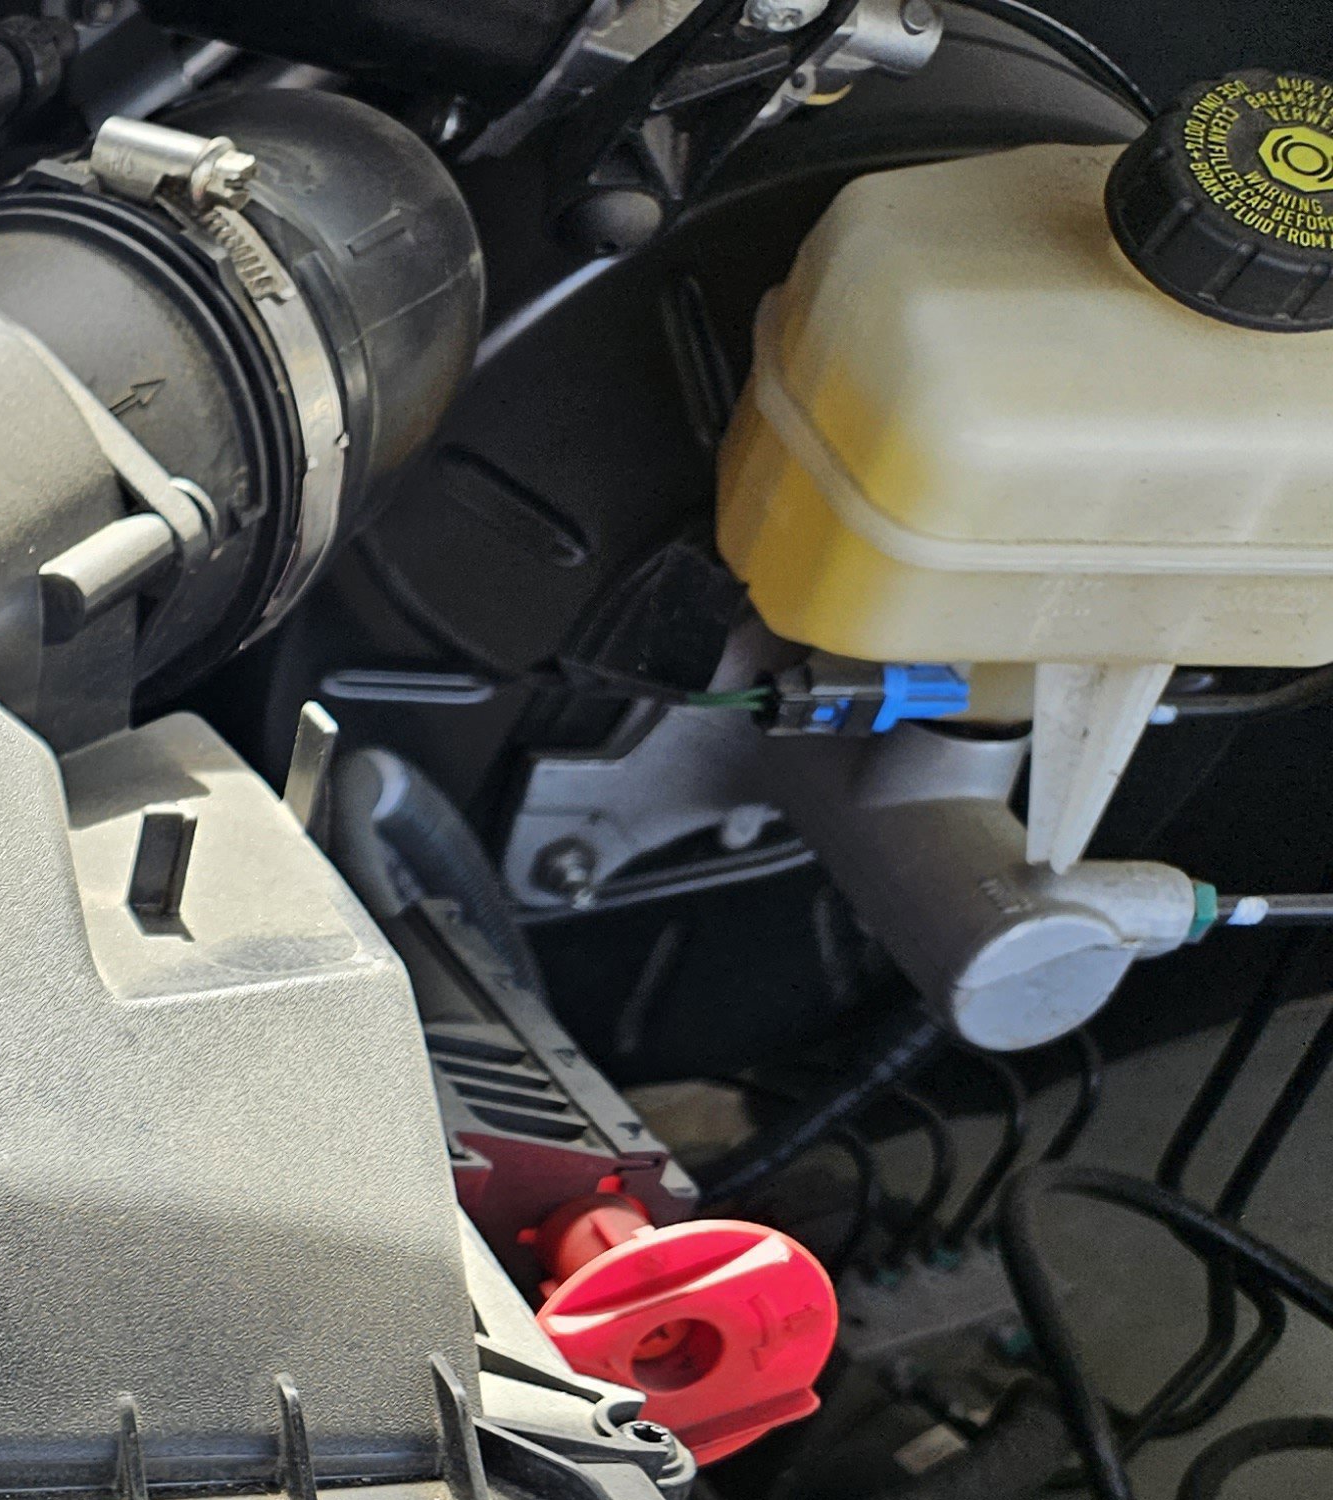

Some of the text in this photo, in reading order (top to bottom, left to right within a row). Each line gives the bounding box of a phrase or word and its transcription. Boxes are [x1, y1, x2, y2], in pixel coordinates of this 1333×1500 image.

[1215, 79, 1251, 100] USE
[1276, 76, 1315, 94] NUR
[1191, 92, 1224, 121] ONLY
[1265, 105, 1333, 131] VERWE
[1207, 106, 1239, 144] CLEAN
[1207, 144, 1244, 190] FILLER
[1189, 162, 1233, 204] BRAKE
[1243, 170, 1323, 214] WARNING
[1237, 188, 1272, 212] CAP
[1225, 200, 1274, 234] FLUID
[1275, 225, 1326, 249] FROM
